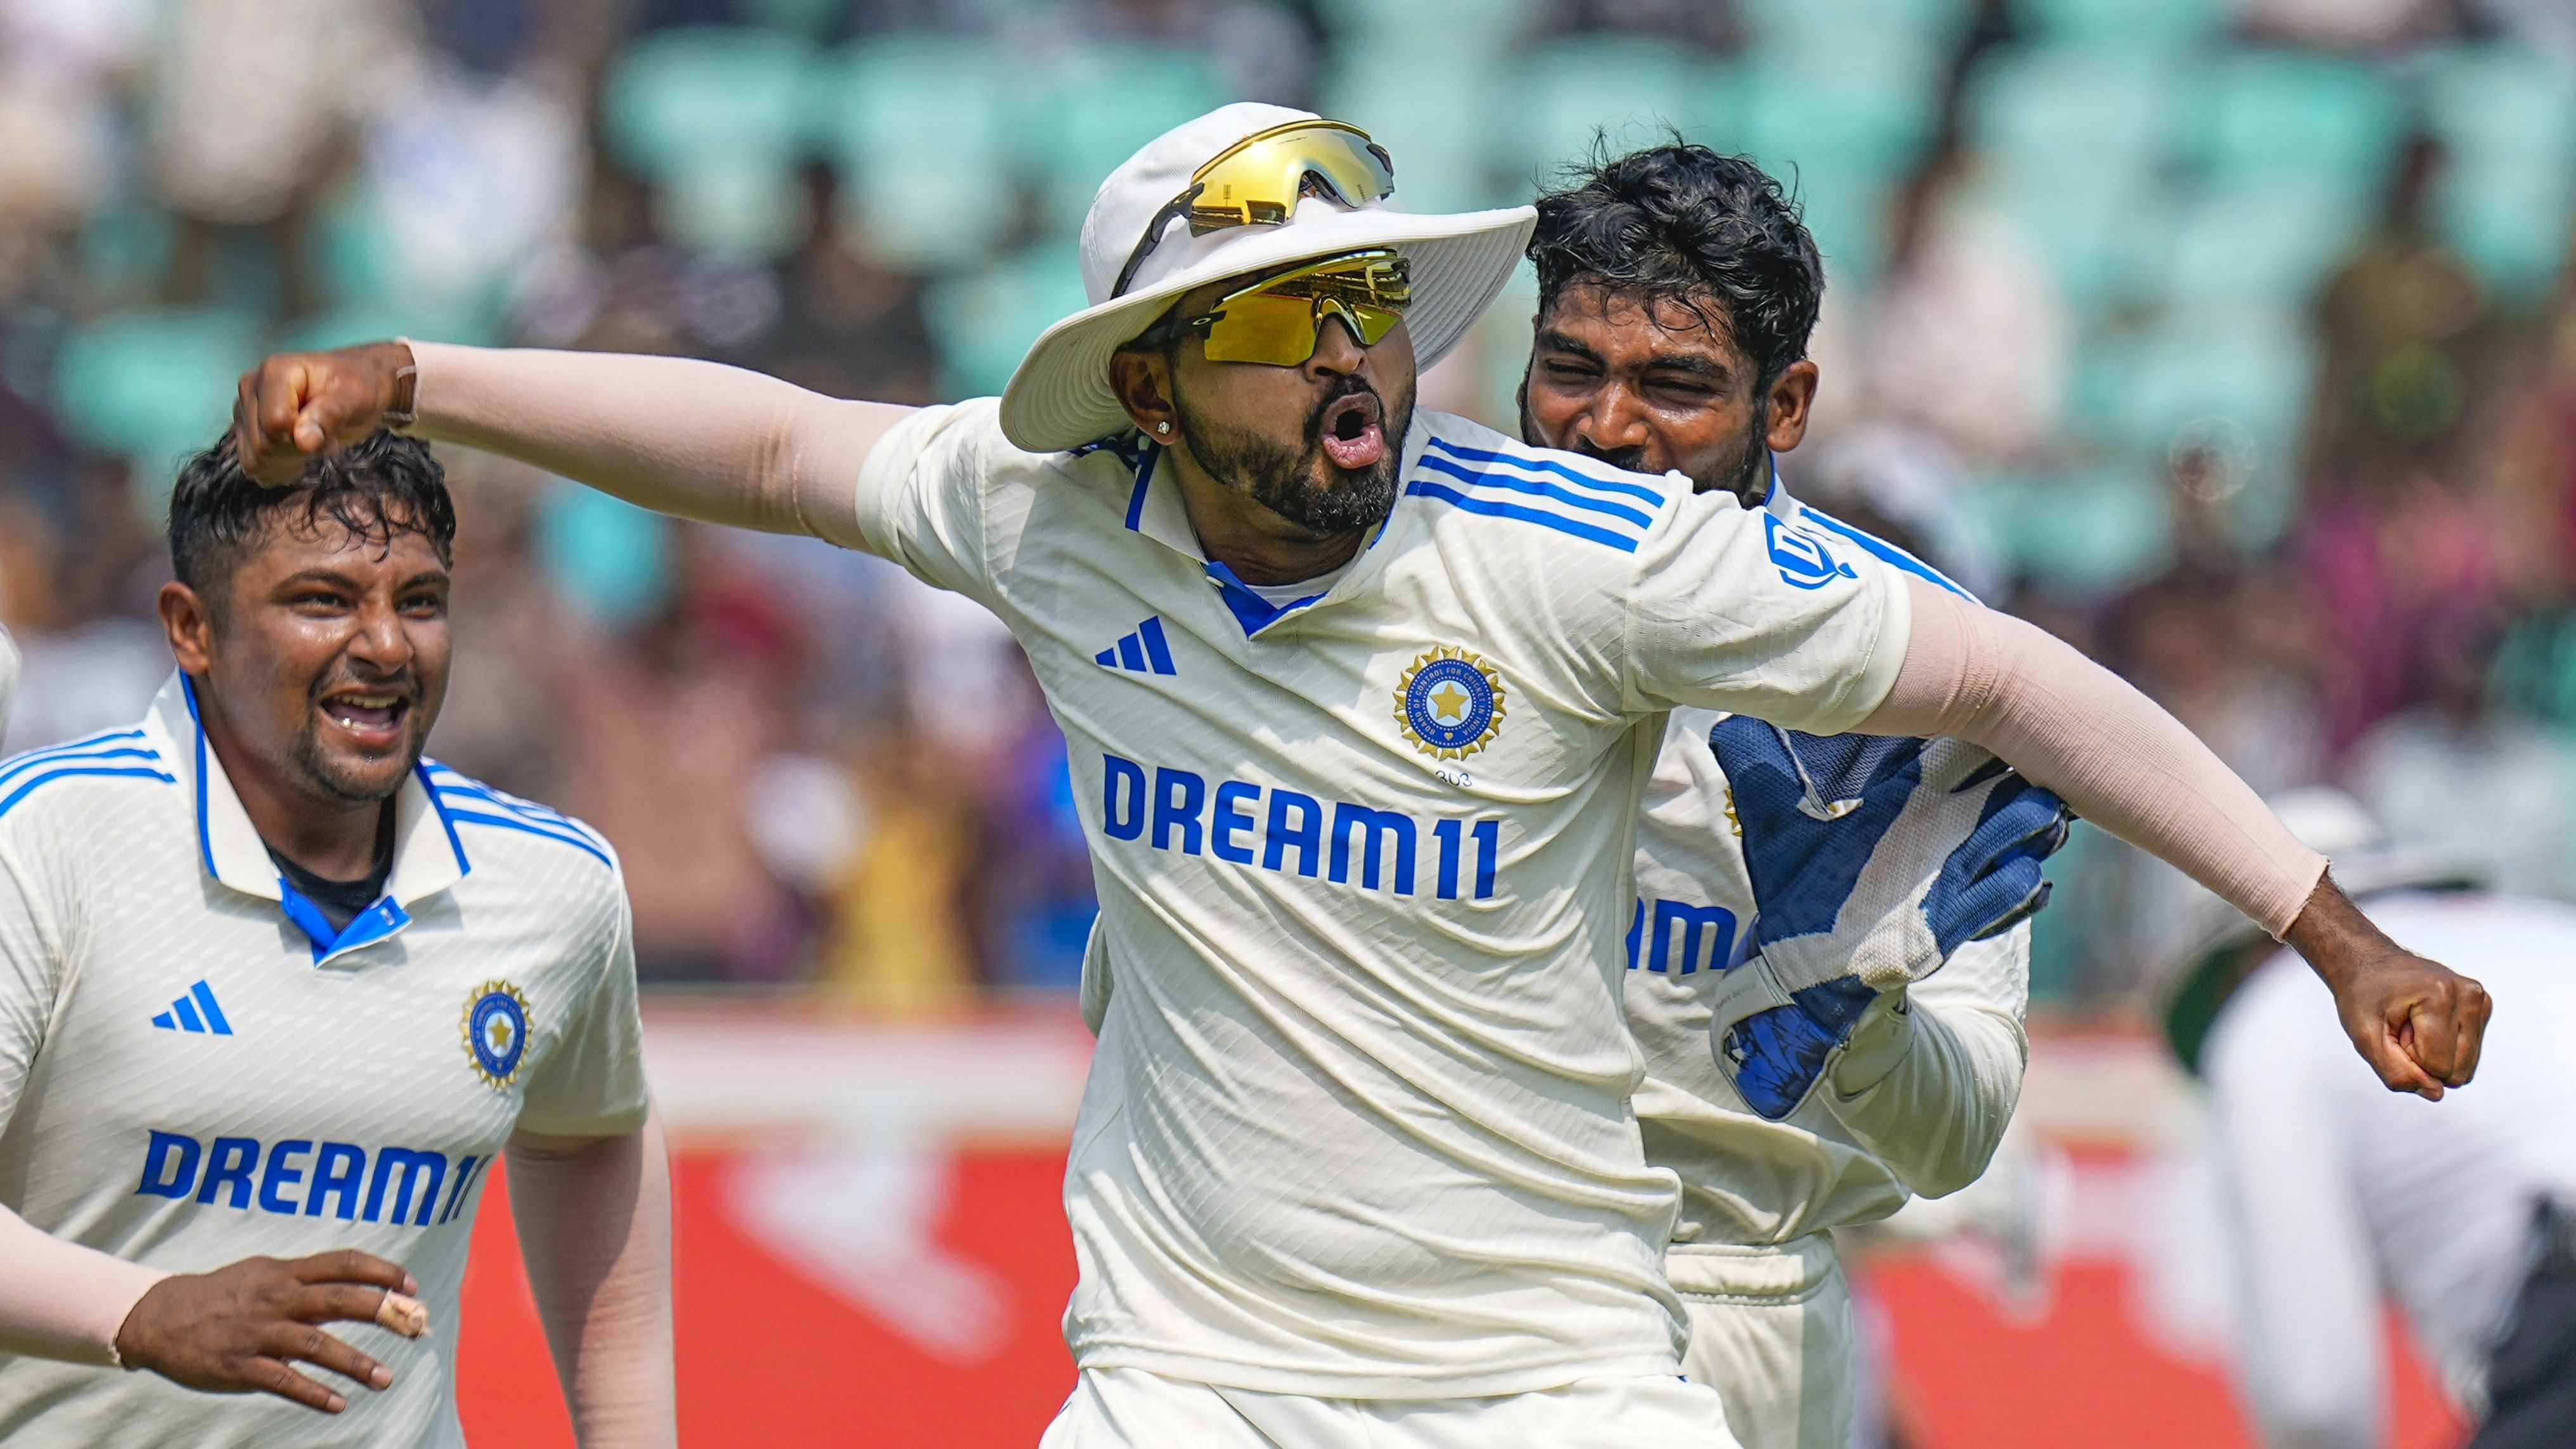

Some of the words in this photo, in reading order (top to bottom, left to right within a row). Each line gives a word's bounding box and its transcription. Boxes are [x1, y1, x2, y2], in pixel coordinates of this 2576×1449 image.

[1446, 667, 1462, 675] FOR
[1415, 669, 1443, 695] CONTROL
[1464, 673, 1485, 701] CRICKET
[1414, 699, 1420, 708] OF
[1478, 705, 1485, 714] IN
[1415, 712, 1436, 735] BOARD
[1462, 716, 1481, 735] INDIA
[1103, 753, 1498, 900] DREAM11
